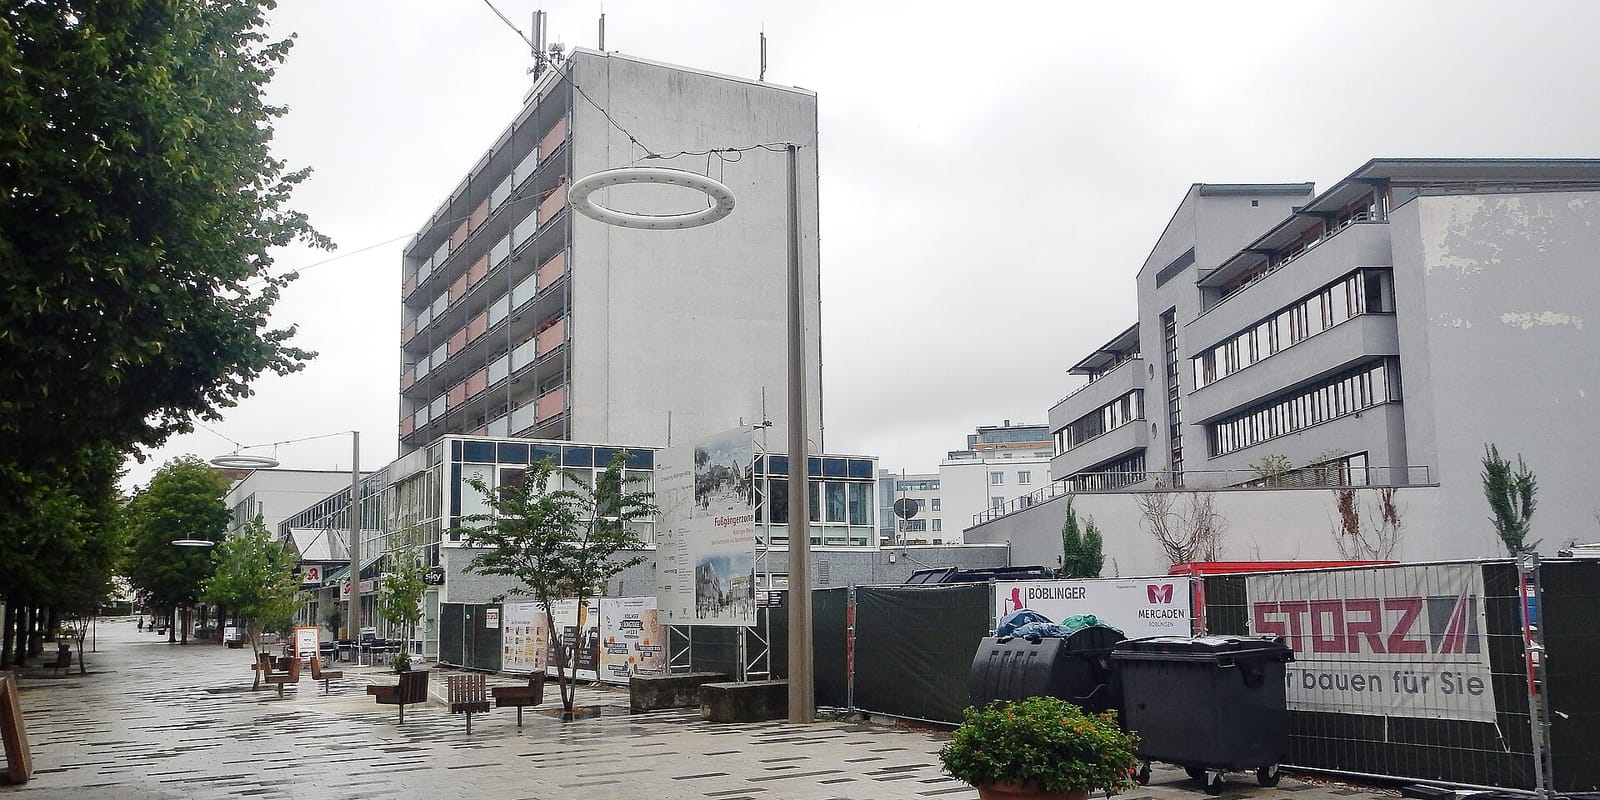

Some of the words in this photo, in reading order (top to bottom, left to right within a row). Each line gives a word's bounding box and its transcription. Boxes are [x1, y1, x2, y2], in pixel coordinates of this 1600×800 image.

[714, 514, 754, 528] Fußgängerzone
[307, 567, 319, 581] A
[425, 571, 442, 582] sky
[1028, 585, 1086, 600] BÖBLINGER
[1138, 608, 1185, 619] MERCADEN
[1253, 596, 1428, 654] STORZ
[1303, 670, 1383, 692] bauen
[1393, 670, 1430, 694] für
[1440, 671, 1485, 696] Sie
